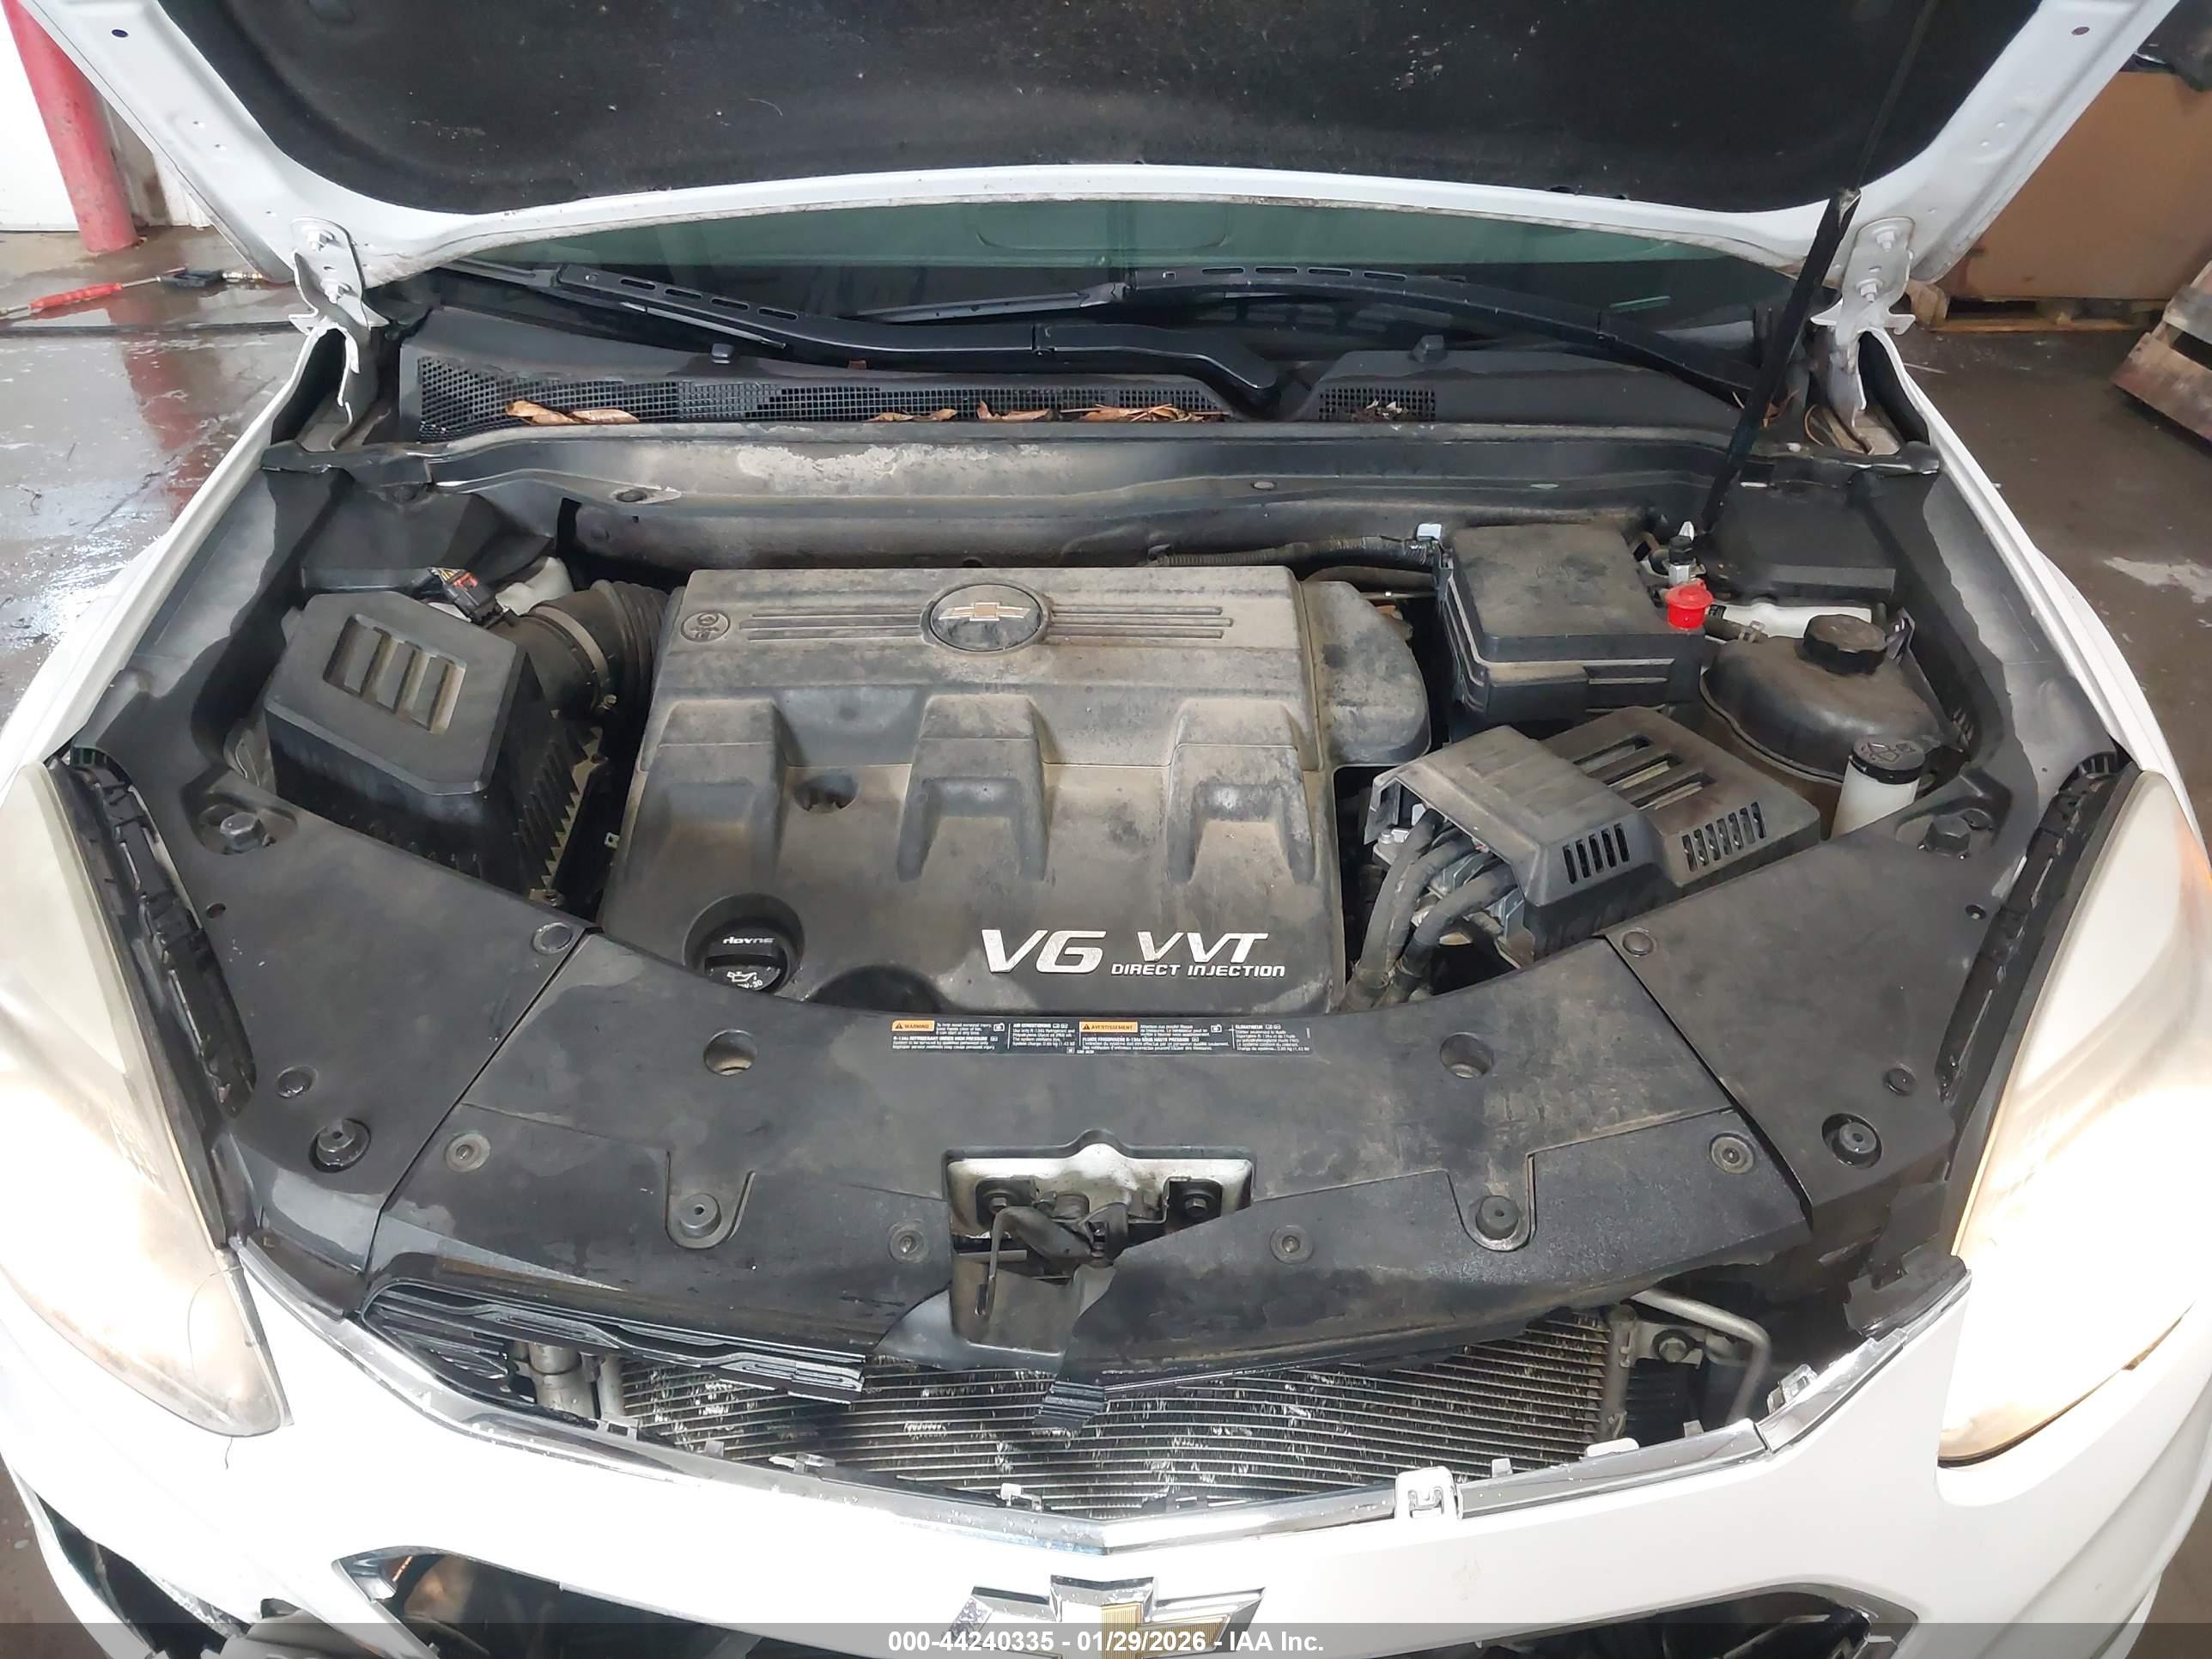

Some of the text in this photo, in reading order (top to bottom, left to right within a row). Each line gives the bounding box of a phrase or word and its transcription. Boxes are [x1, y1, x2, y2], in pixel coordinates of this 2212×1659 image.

[981, 929, 1107, 973] V6
[1137, 931, 1269, 963] VVT
[1111, 963, 1285, 977] DIRECT INJECTION
